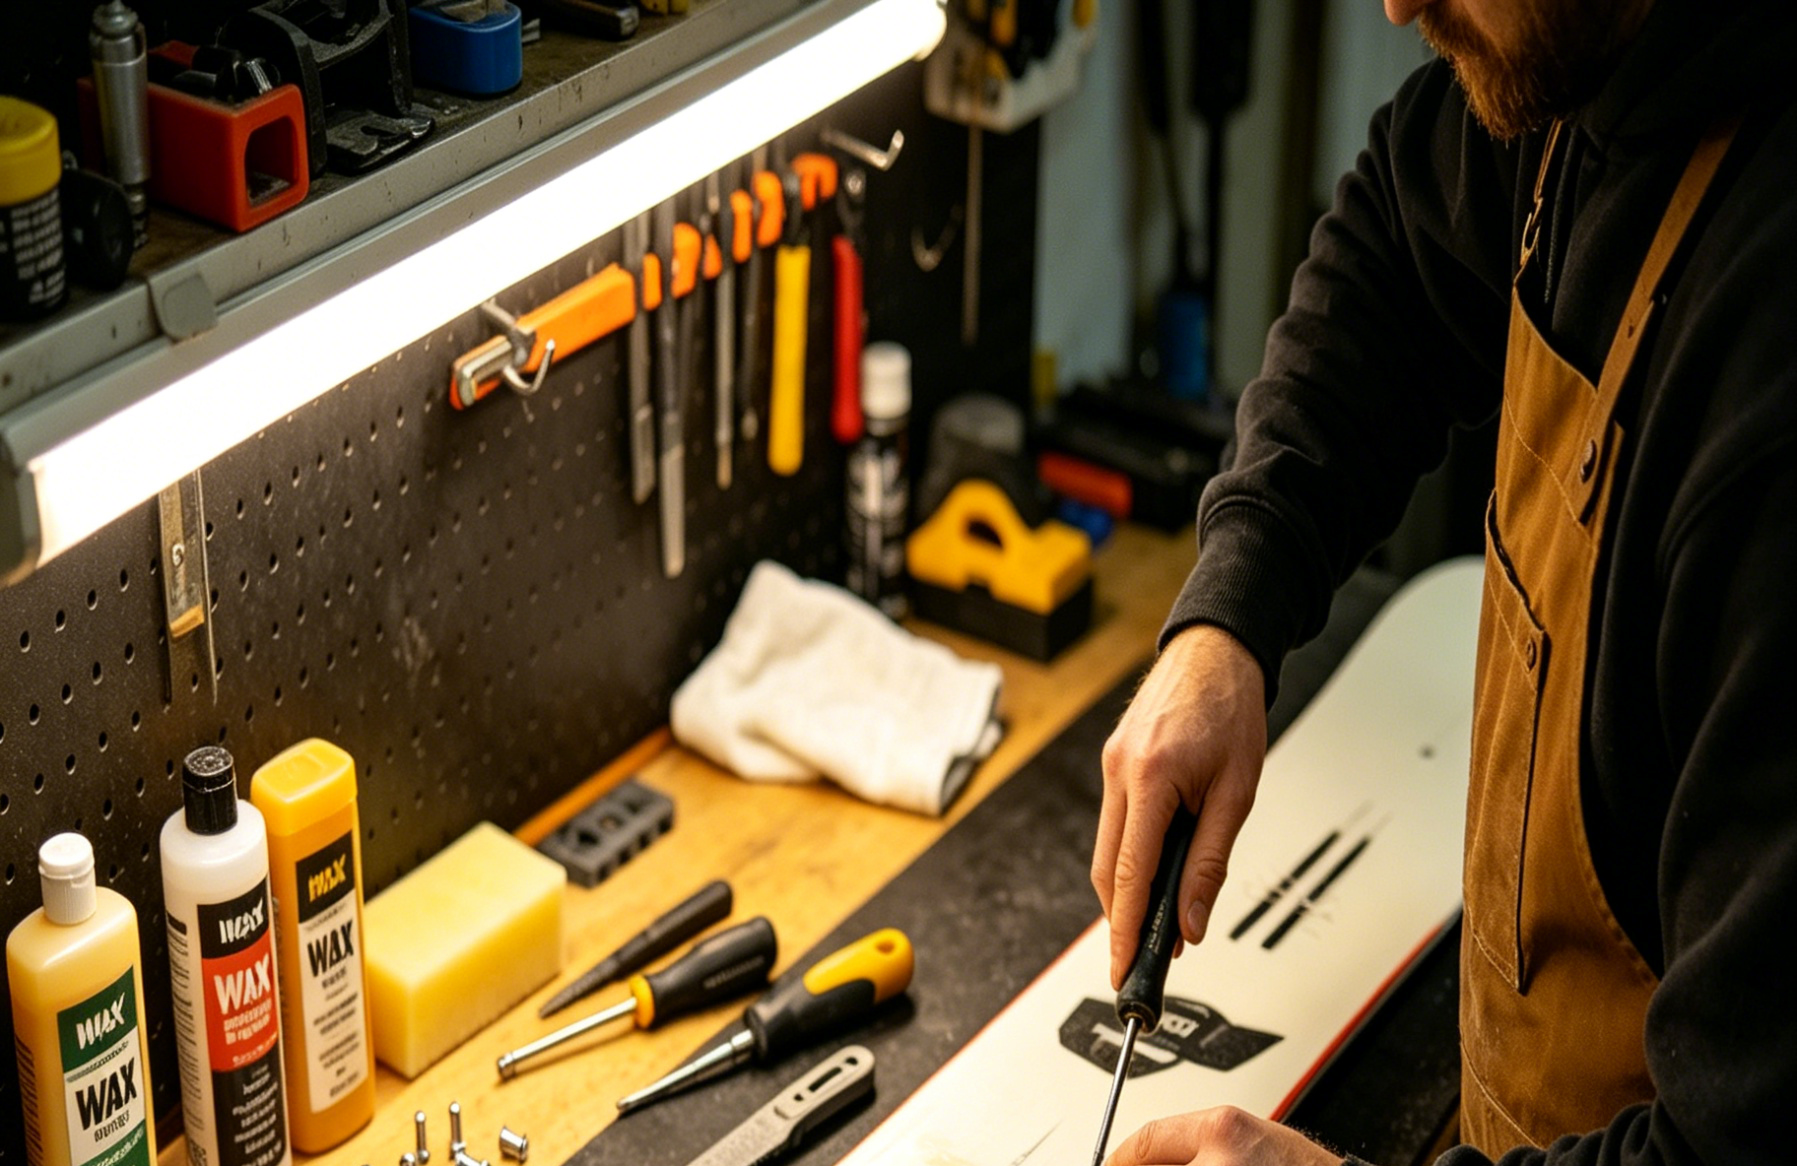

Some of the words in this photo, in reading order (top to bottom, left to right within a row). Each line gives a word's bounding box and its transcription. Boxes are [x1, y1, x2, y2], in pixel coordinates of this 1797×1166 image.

[307, 918, 354, 978] WAX
[214, 952, 271, 1015] WAX
[76, 991, 126, 1050] WAX
[75, 1056, 138, 1131] WAX
